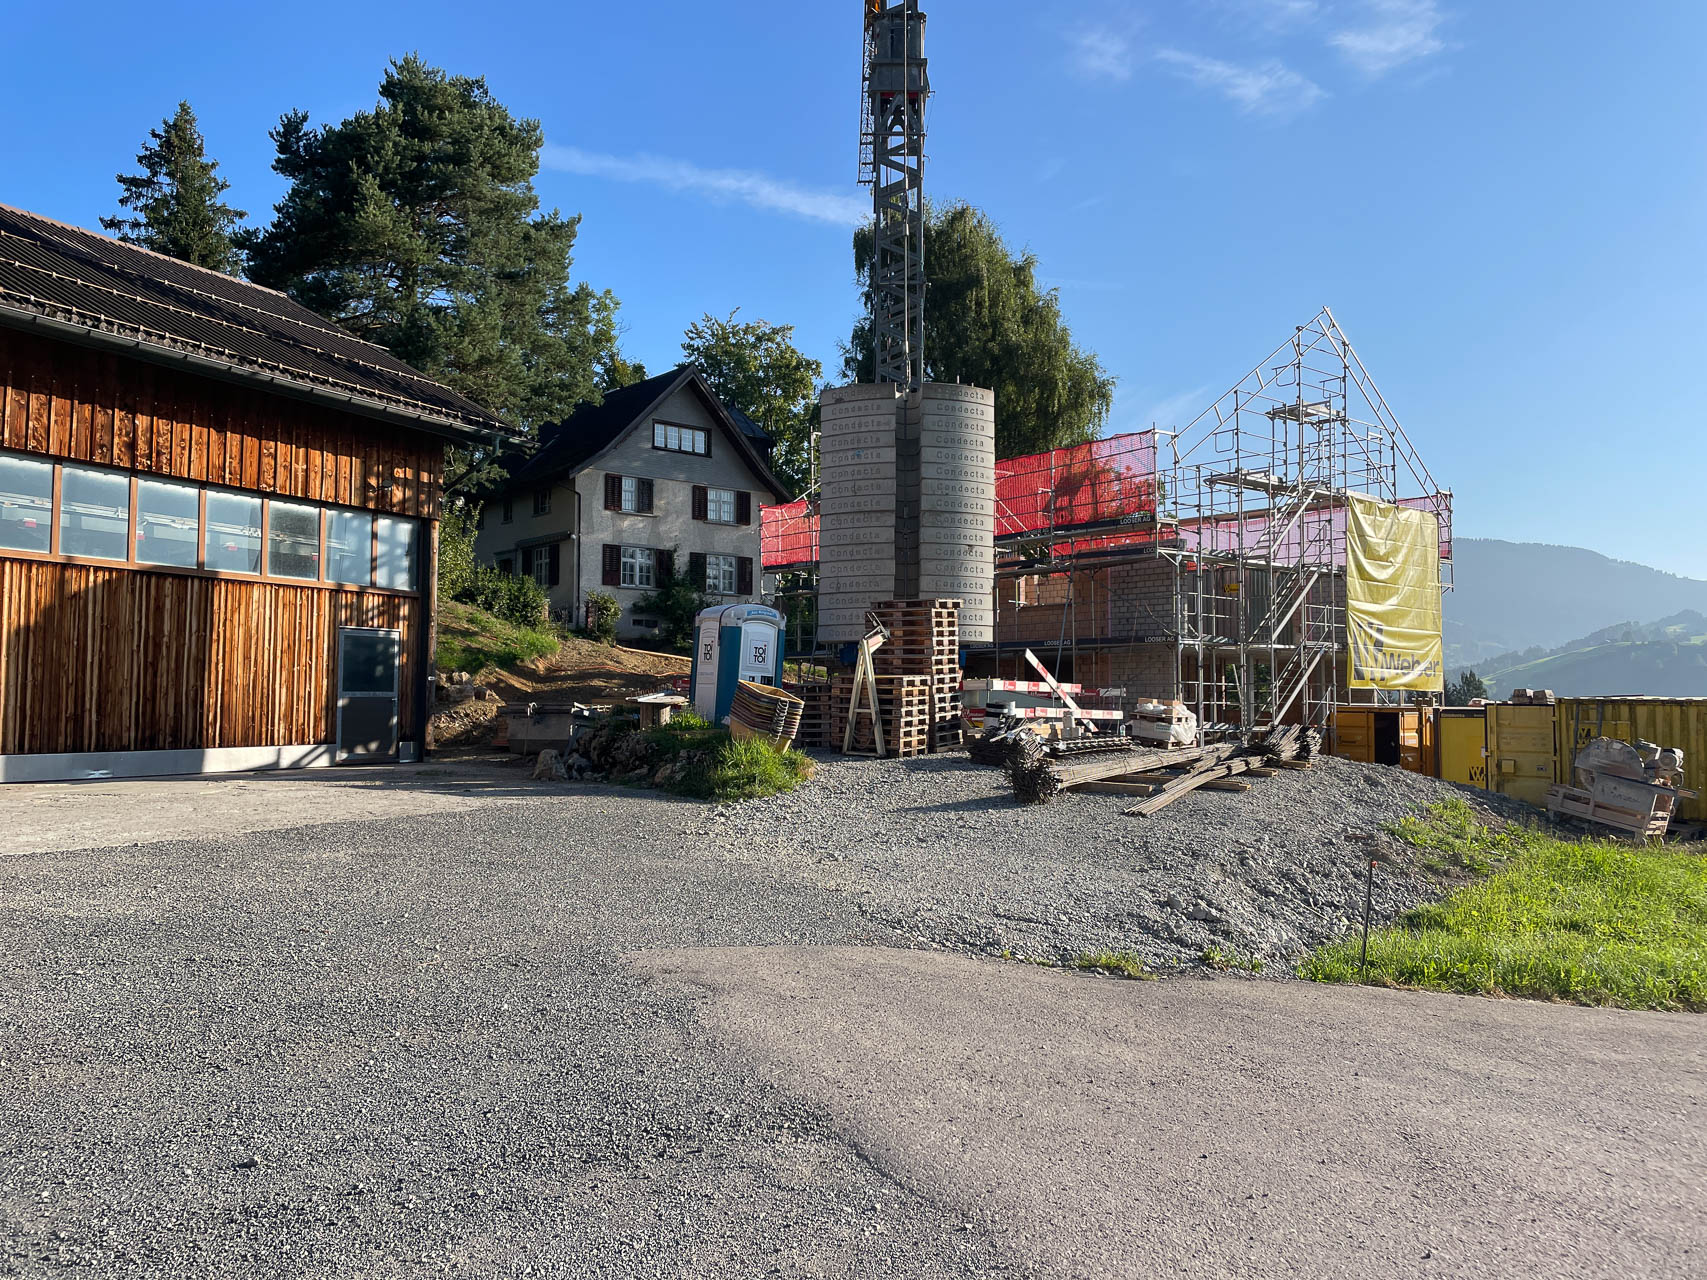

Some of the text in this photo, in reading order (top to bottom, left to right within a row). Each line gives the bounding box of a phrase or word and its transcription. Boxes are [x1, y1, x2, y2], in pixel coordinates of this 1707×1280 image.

[937, 403, 984, 416] Condecta
[937, 420, 984, 431] Condecta
[936, 436, 984, 447] Condecta
[937, 451, 984, 463] Condecta
[936, 467, 984, 478] Condecta
[937, 483, 984, 494] Condecta
[936, 499, 984, 510] Condecta
[1383, 652, 1440, 678] Weber
